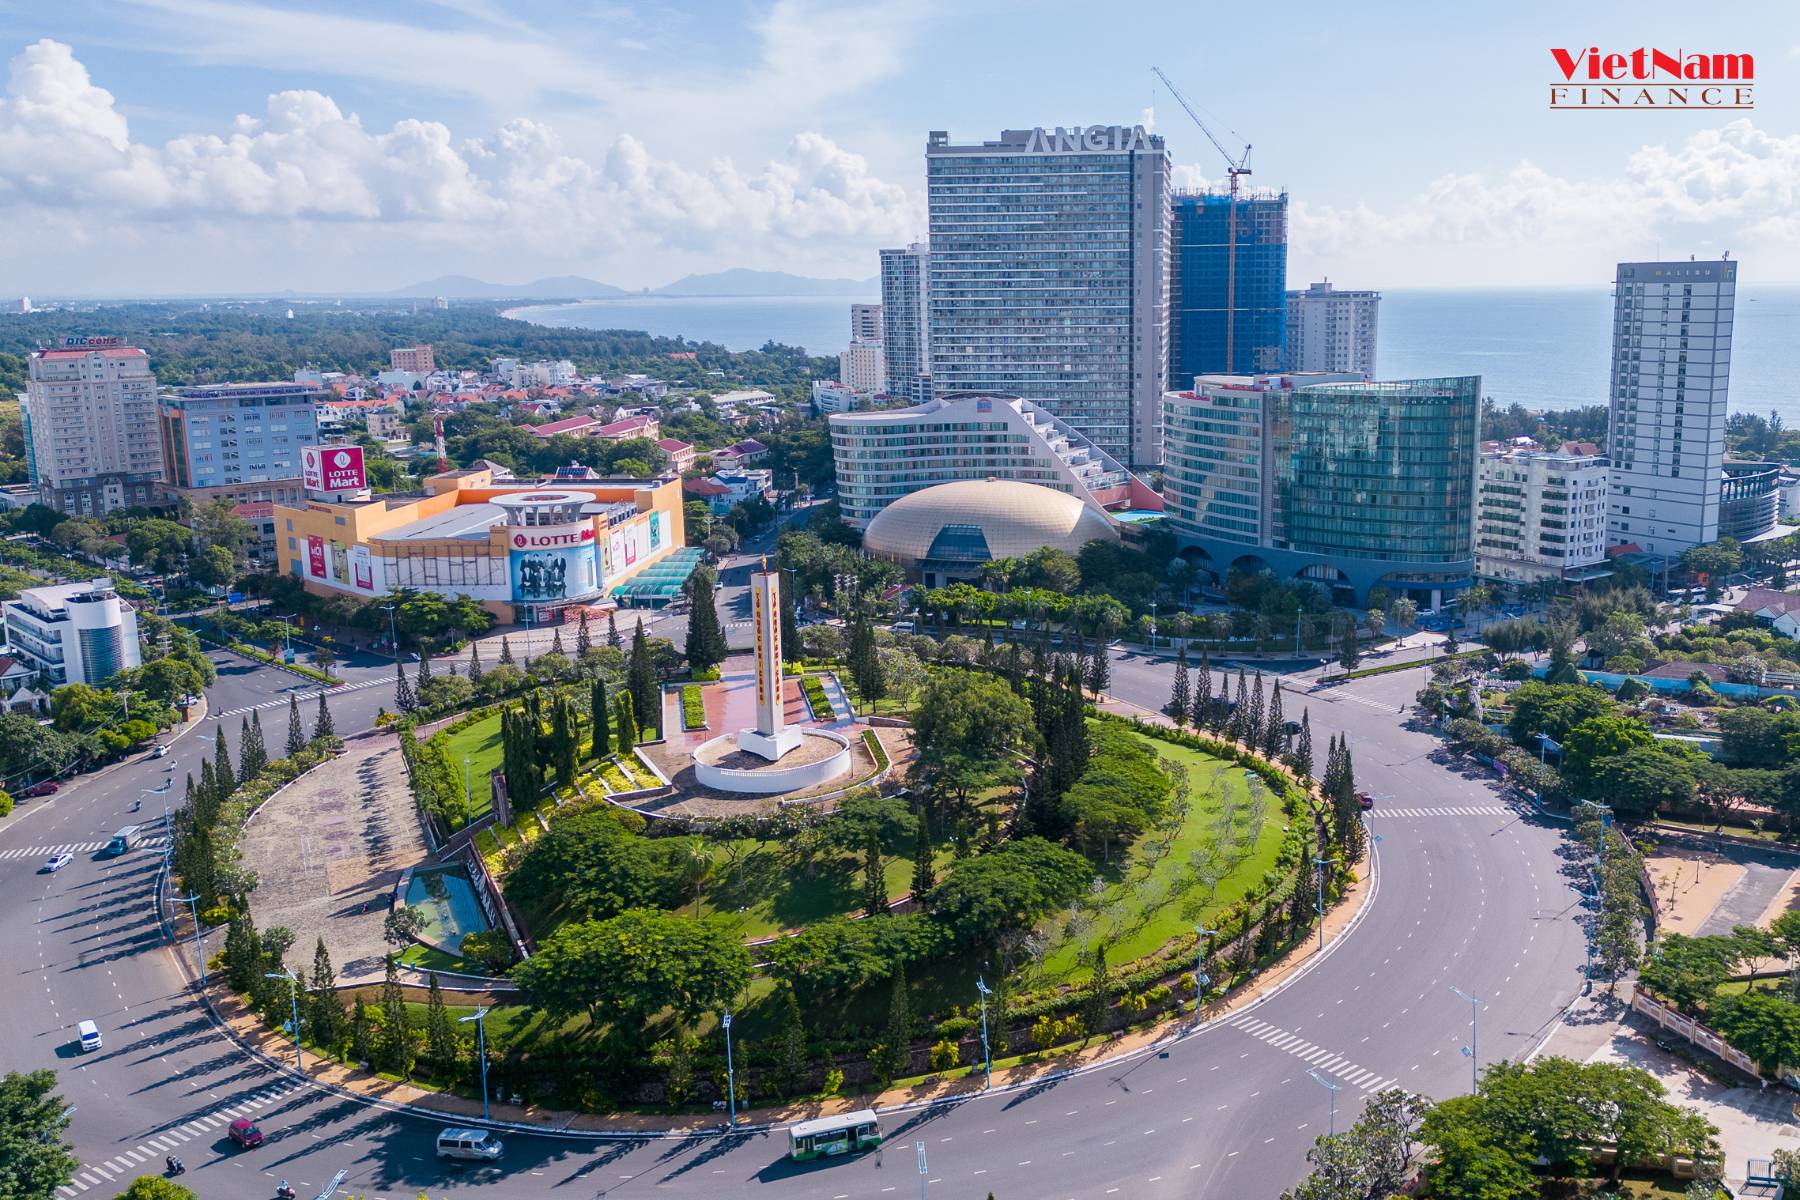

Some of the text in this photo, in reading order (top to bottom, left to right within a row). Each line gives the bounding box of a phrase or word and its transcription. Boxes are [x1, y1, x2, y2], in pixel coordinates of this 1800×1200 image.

[328, 469, 359, 478] LOTTE
[330, 476, 360, 488] Mart
[530, 533, 578, 546] LOTTE
